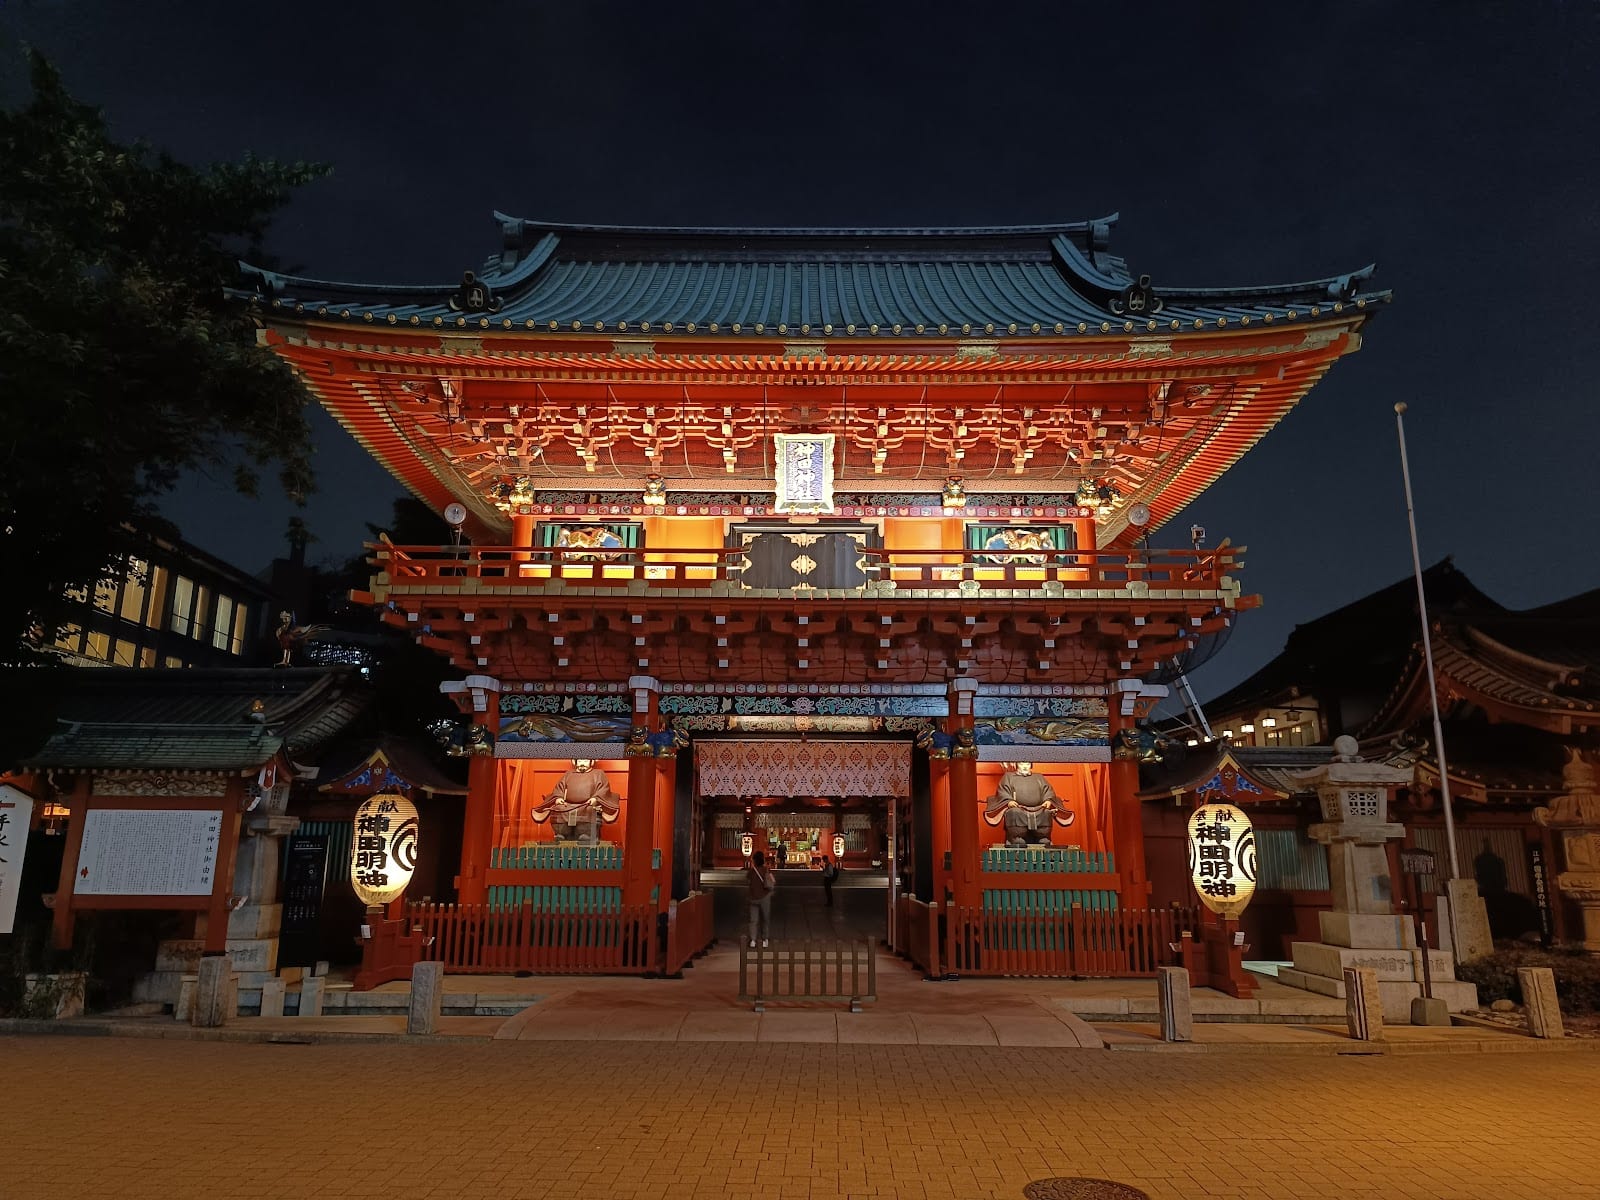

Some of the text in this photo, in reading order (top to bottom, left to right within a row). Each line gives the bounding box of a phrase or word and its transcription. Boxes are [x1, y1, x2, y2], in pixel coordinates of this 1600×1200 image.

[356, 814, 390, 887] 神田明神
[1195, 823, 1236, 897] 神田明神
